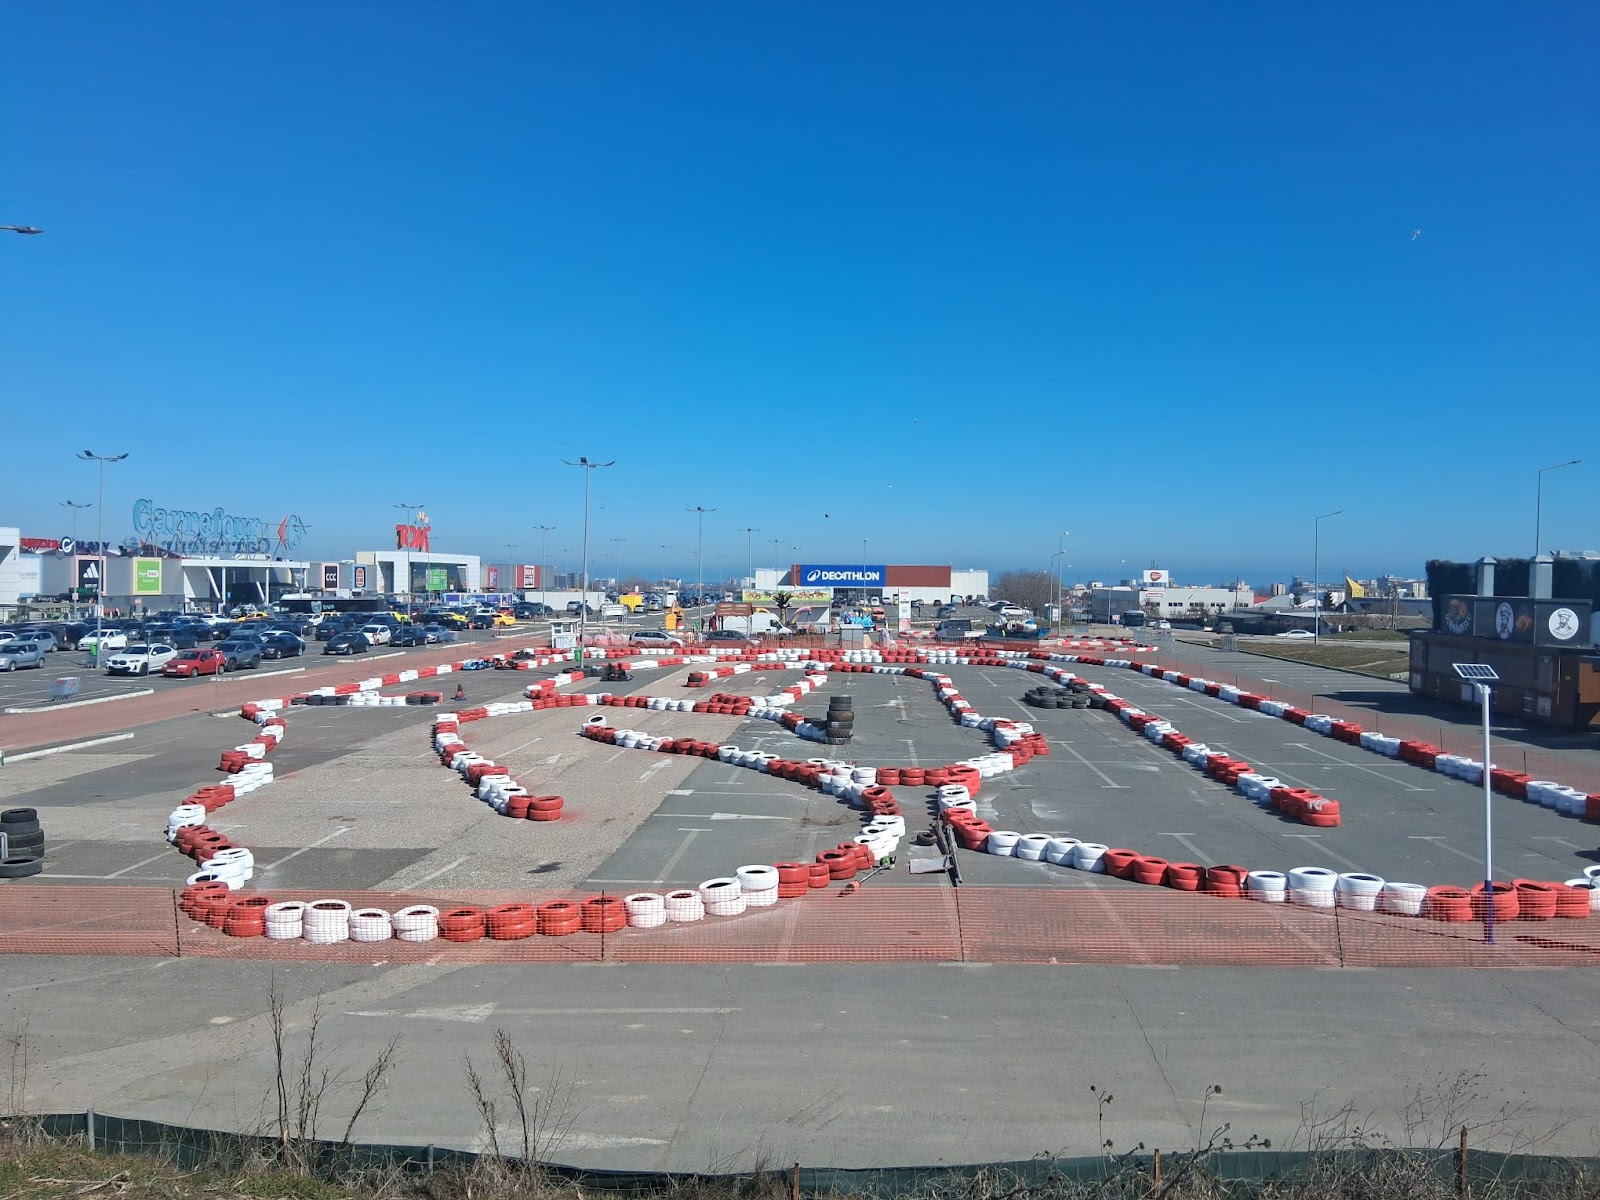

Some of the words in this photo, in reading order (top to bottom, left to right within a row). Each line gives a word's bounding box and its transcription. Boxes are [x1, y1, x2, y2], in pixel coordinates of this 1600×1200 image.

[132, 498, 262, 540] Carrefour
[325, 572, 337, 582] CCC
[821, 571, 880, 581] DECATHLON
